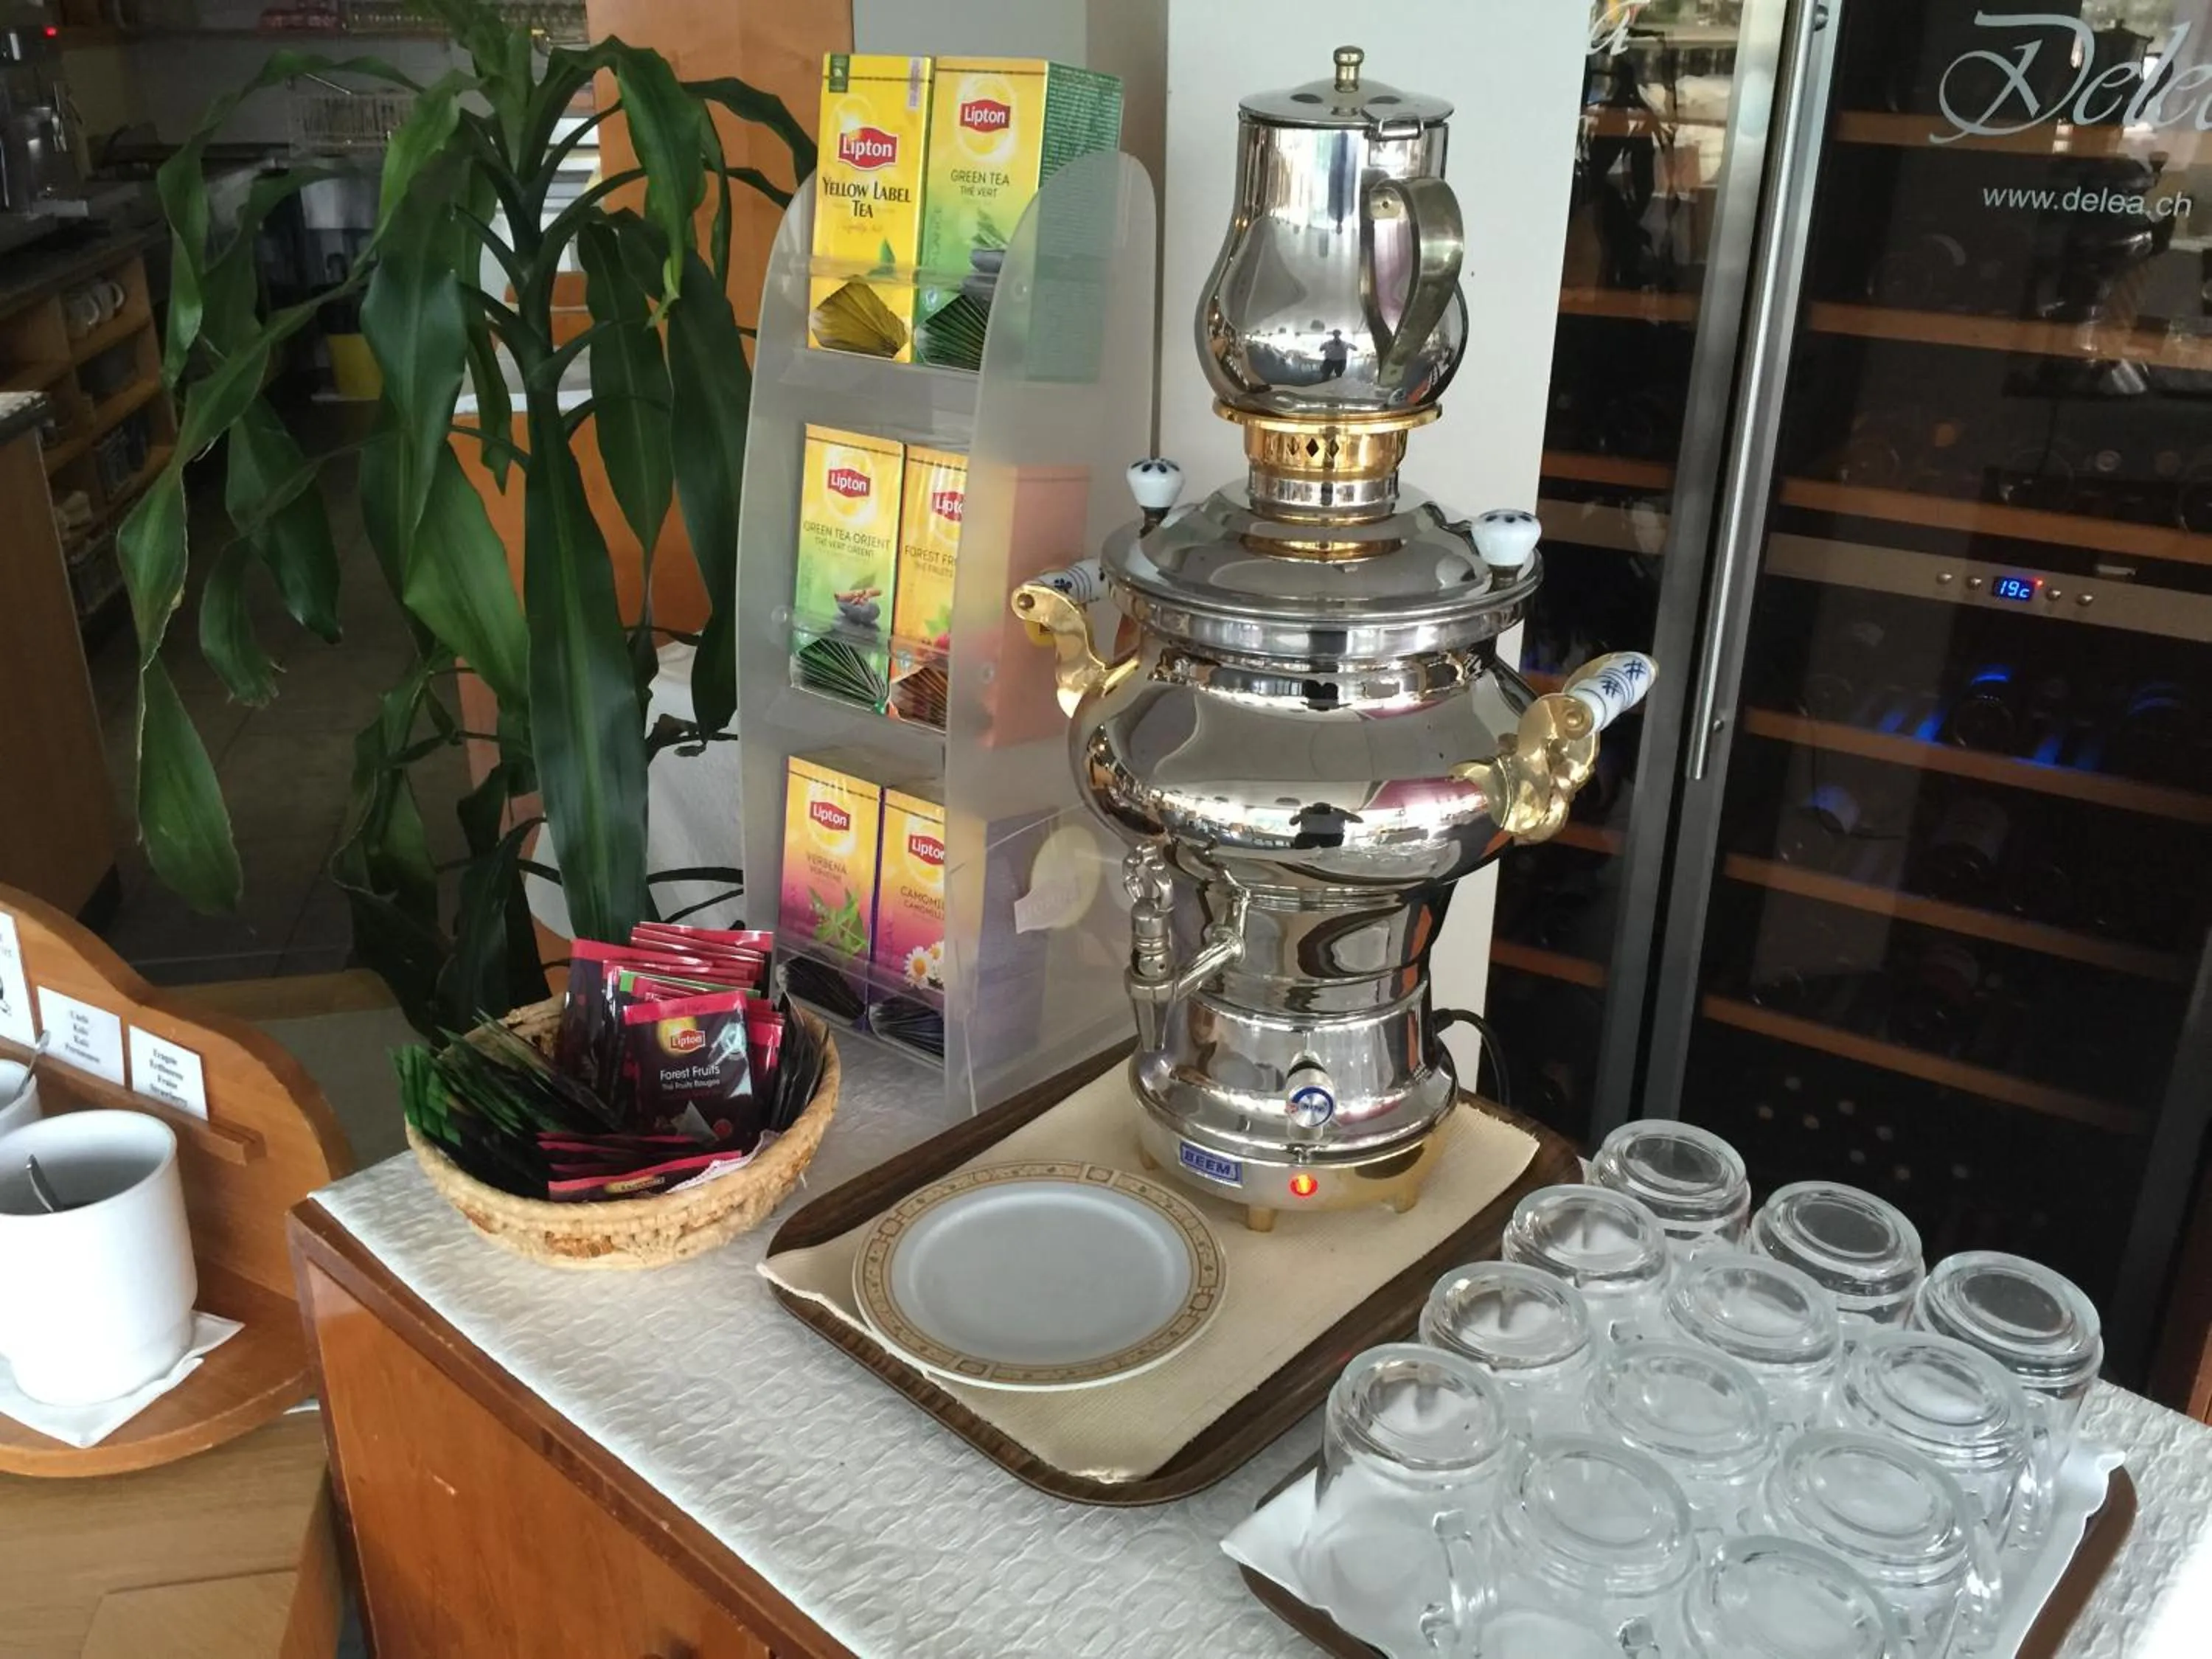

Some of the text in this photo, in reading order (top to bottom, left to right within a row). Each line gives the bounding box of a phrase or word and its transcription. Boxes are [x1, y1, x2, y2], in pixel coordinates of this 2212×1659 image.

[963, 105, 1006, 125] Lipton
[842, 135, 893, 160] Lipton
[950, 169, 1010, 187] GREEN TEA
[822, 176, 911, 203] YELLOW LABEL
[852, 200, 873, 218] TEA
[1983, 186, 2192, 218] www.delea.ch
[830, 471, 867, 493] Lipton
[803, 520, 891, 550] GREEN TEA ORIENT
[905, 545, 940, 563] FOREST
[813, 803, 847, 827] Lipton
[672, 1034, 703, 1048] Lipton
[660, 1065, 720, 1081] Forest Fruits
[1185, 1150, 1231, 1176] BEEM
